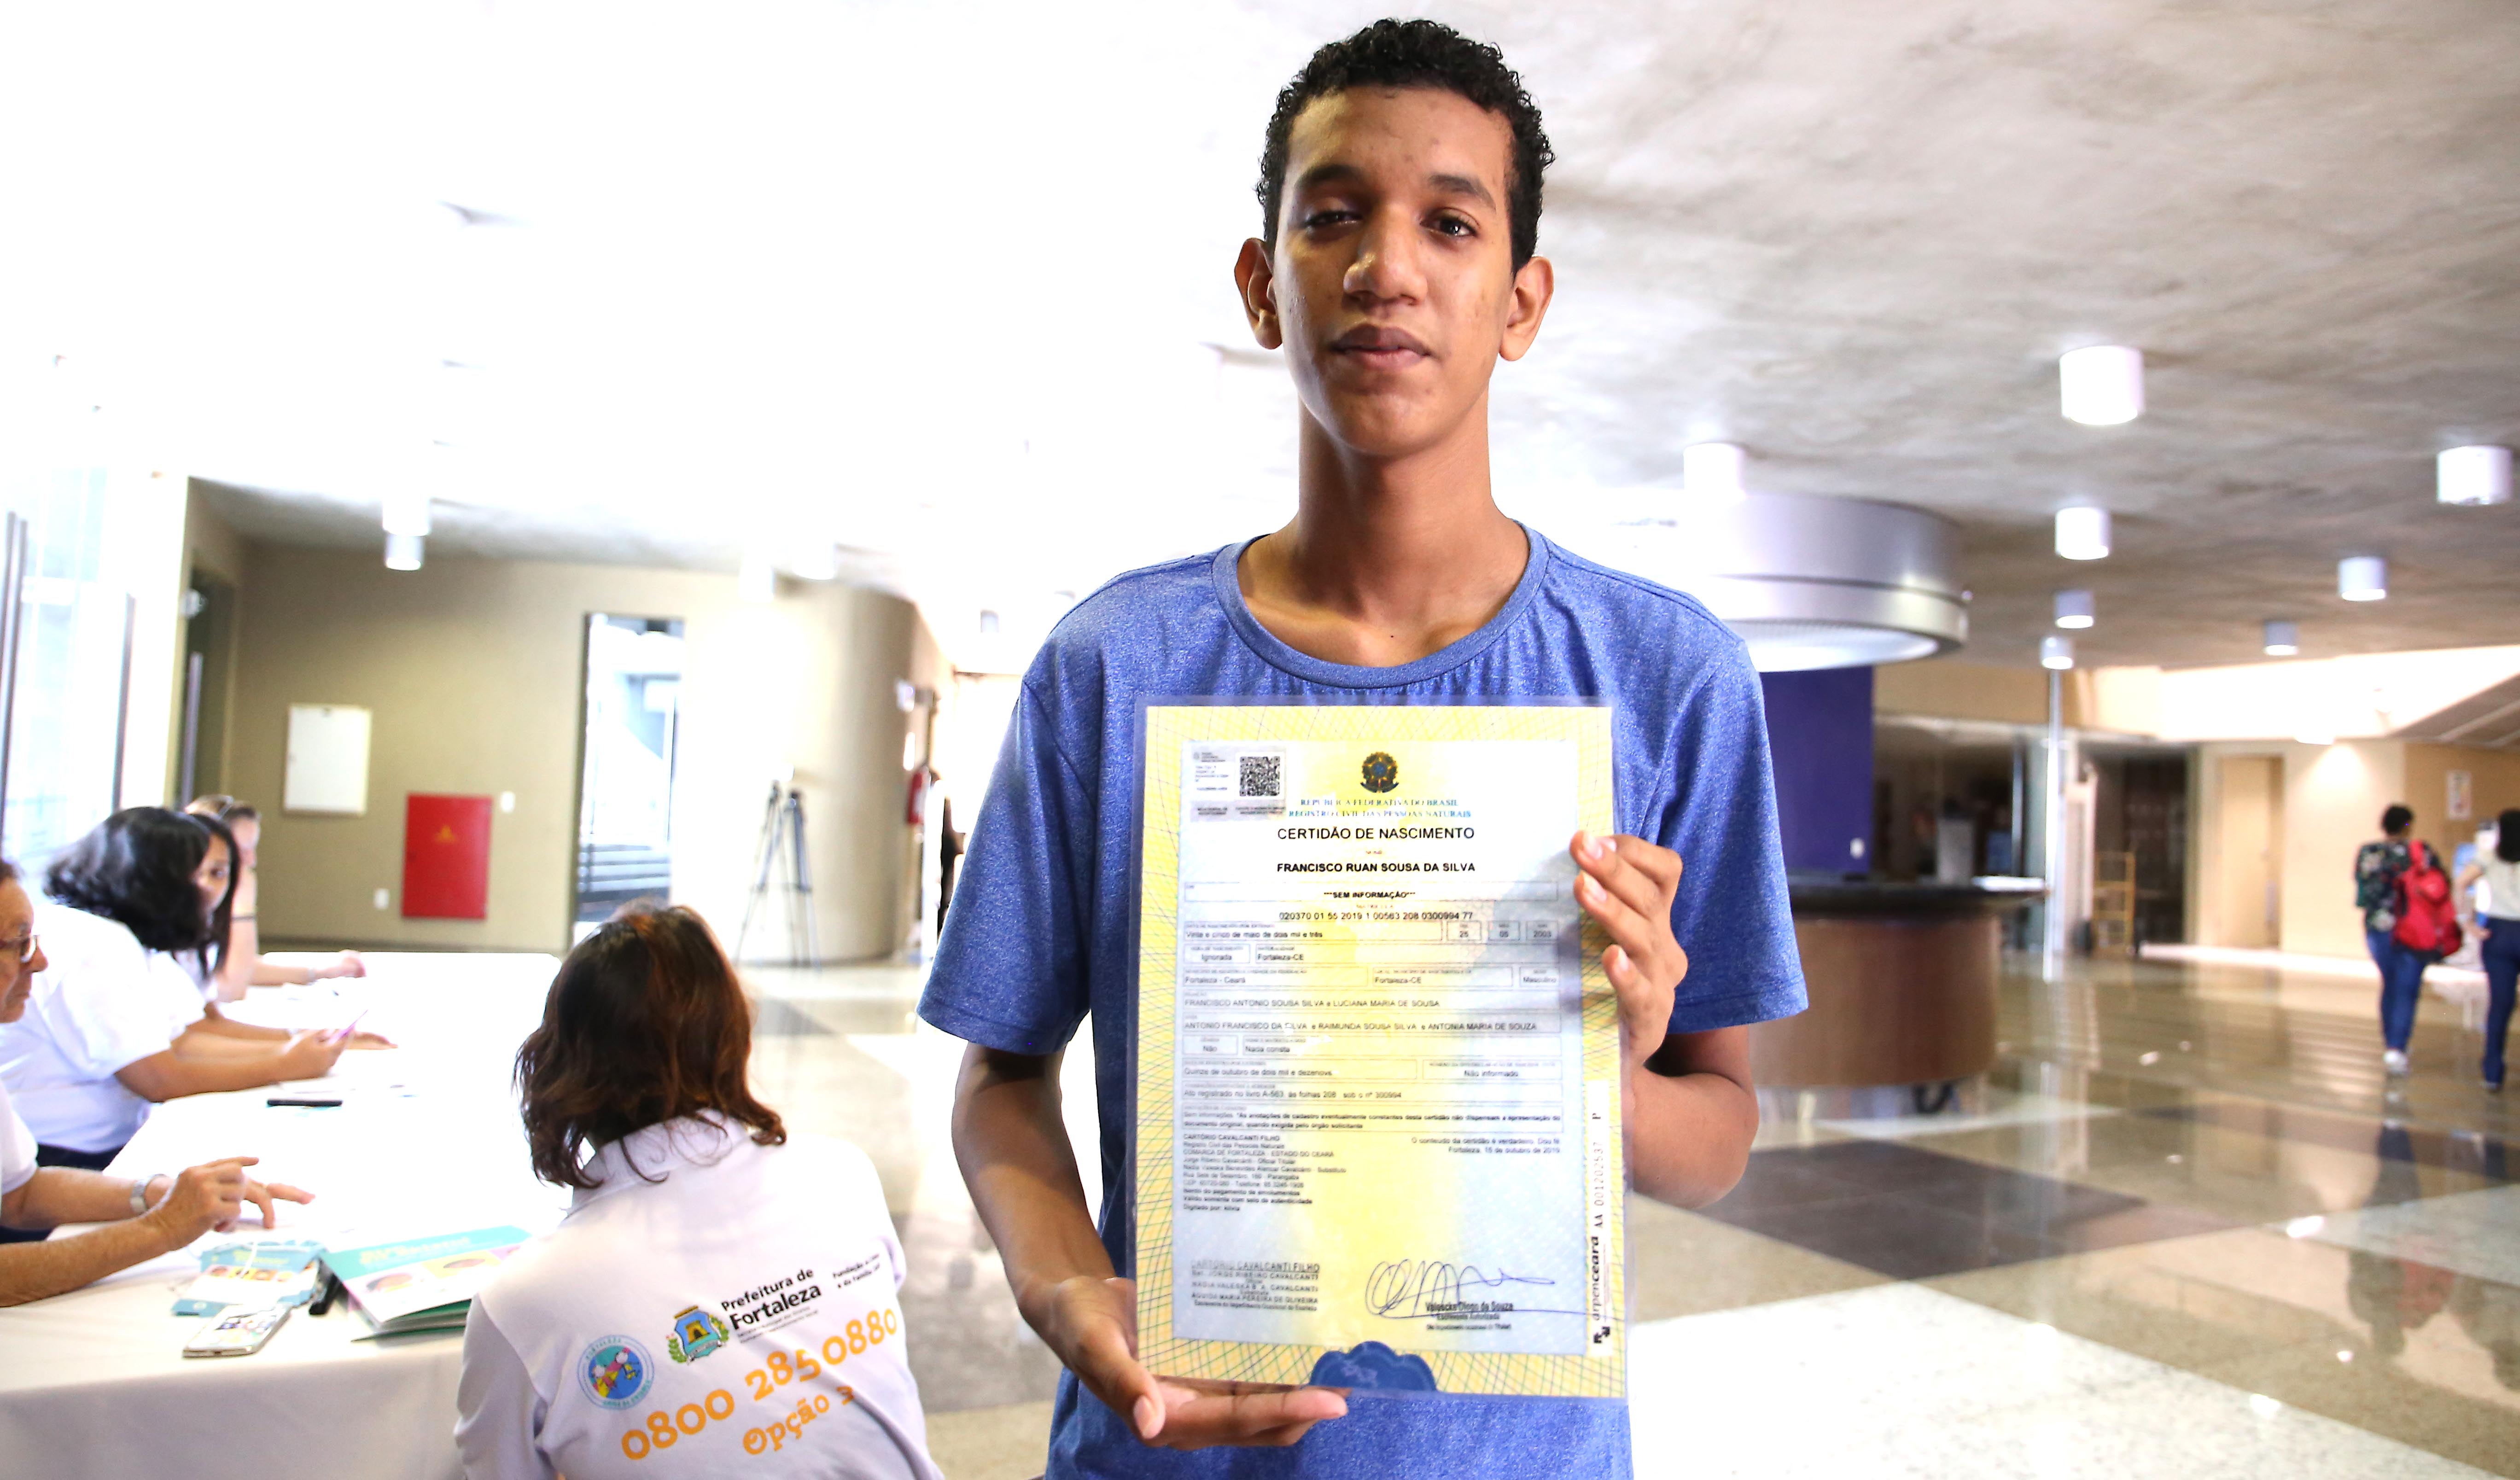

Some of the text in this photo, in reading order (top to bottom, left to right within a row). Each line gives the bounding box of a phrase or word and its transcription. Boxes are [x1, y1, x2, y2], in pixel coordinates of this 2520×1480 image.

[1278, 826, 1475, 839] CERTIDÃO DE NASCIMENTO
[1277, 863, 1475, 872] FRANCISCO RUAN SOUSA DA SILVA
[721, 1268, 814, 1311] Prefeitura de
[729, 1284, 822, 1330] Fortaleza
[621, 1389, 735, 1460] 0800
[742, 1394, 829, 1455] Opção
